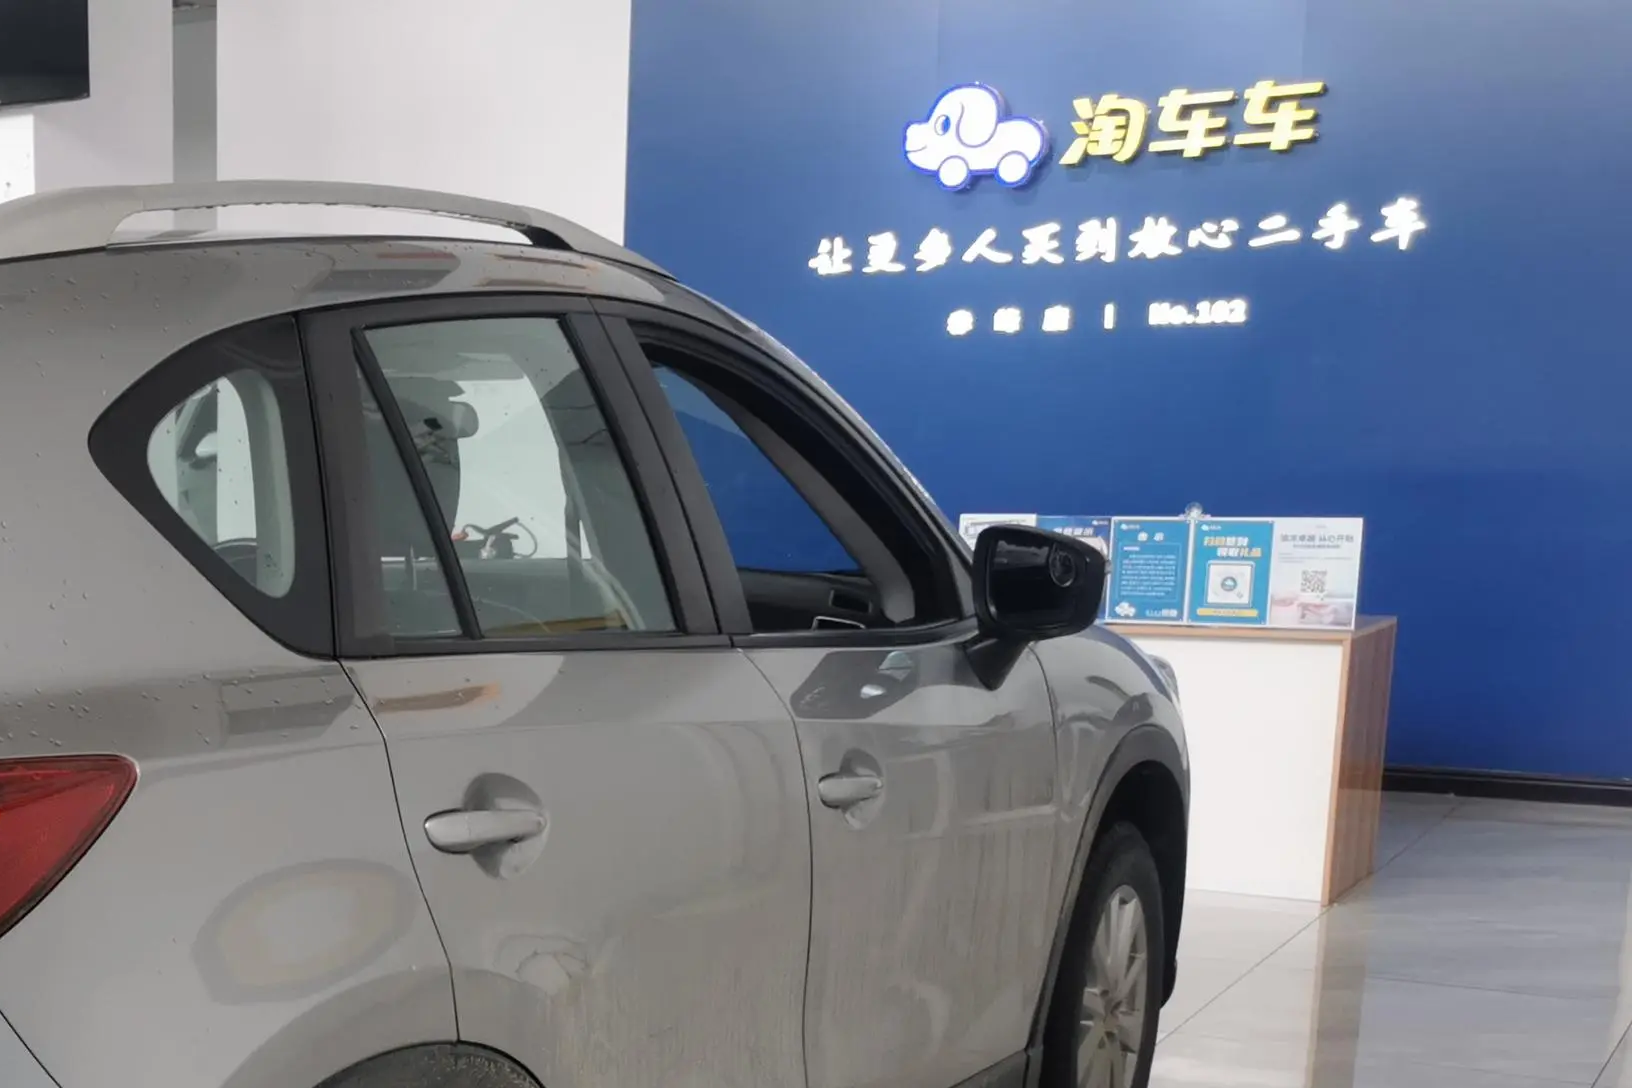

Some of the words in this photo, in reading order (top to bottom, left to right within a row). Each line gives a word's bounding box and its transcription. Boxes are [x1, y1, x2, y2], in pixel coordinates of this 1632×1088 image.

[1058, 80, 1325, 165] 淘车车
[808, 197, 1427, 276] 让更多人买到放心二手车
